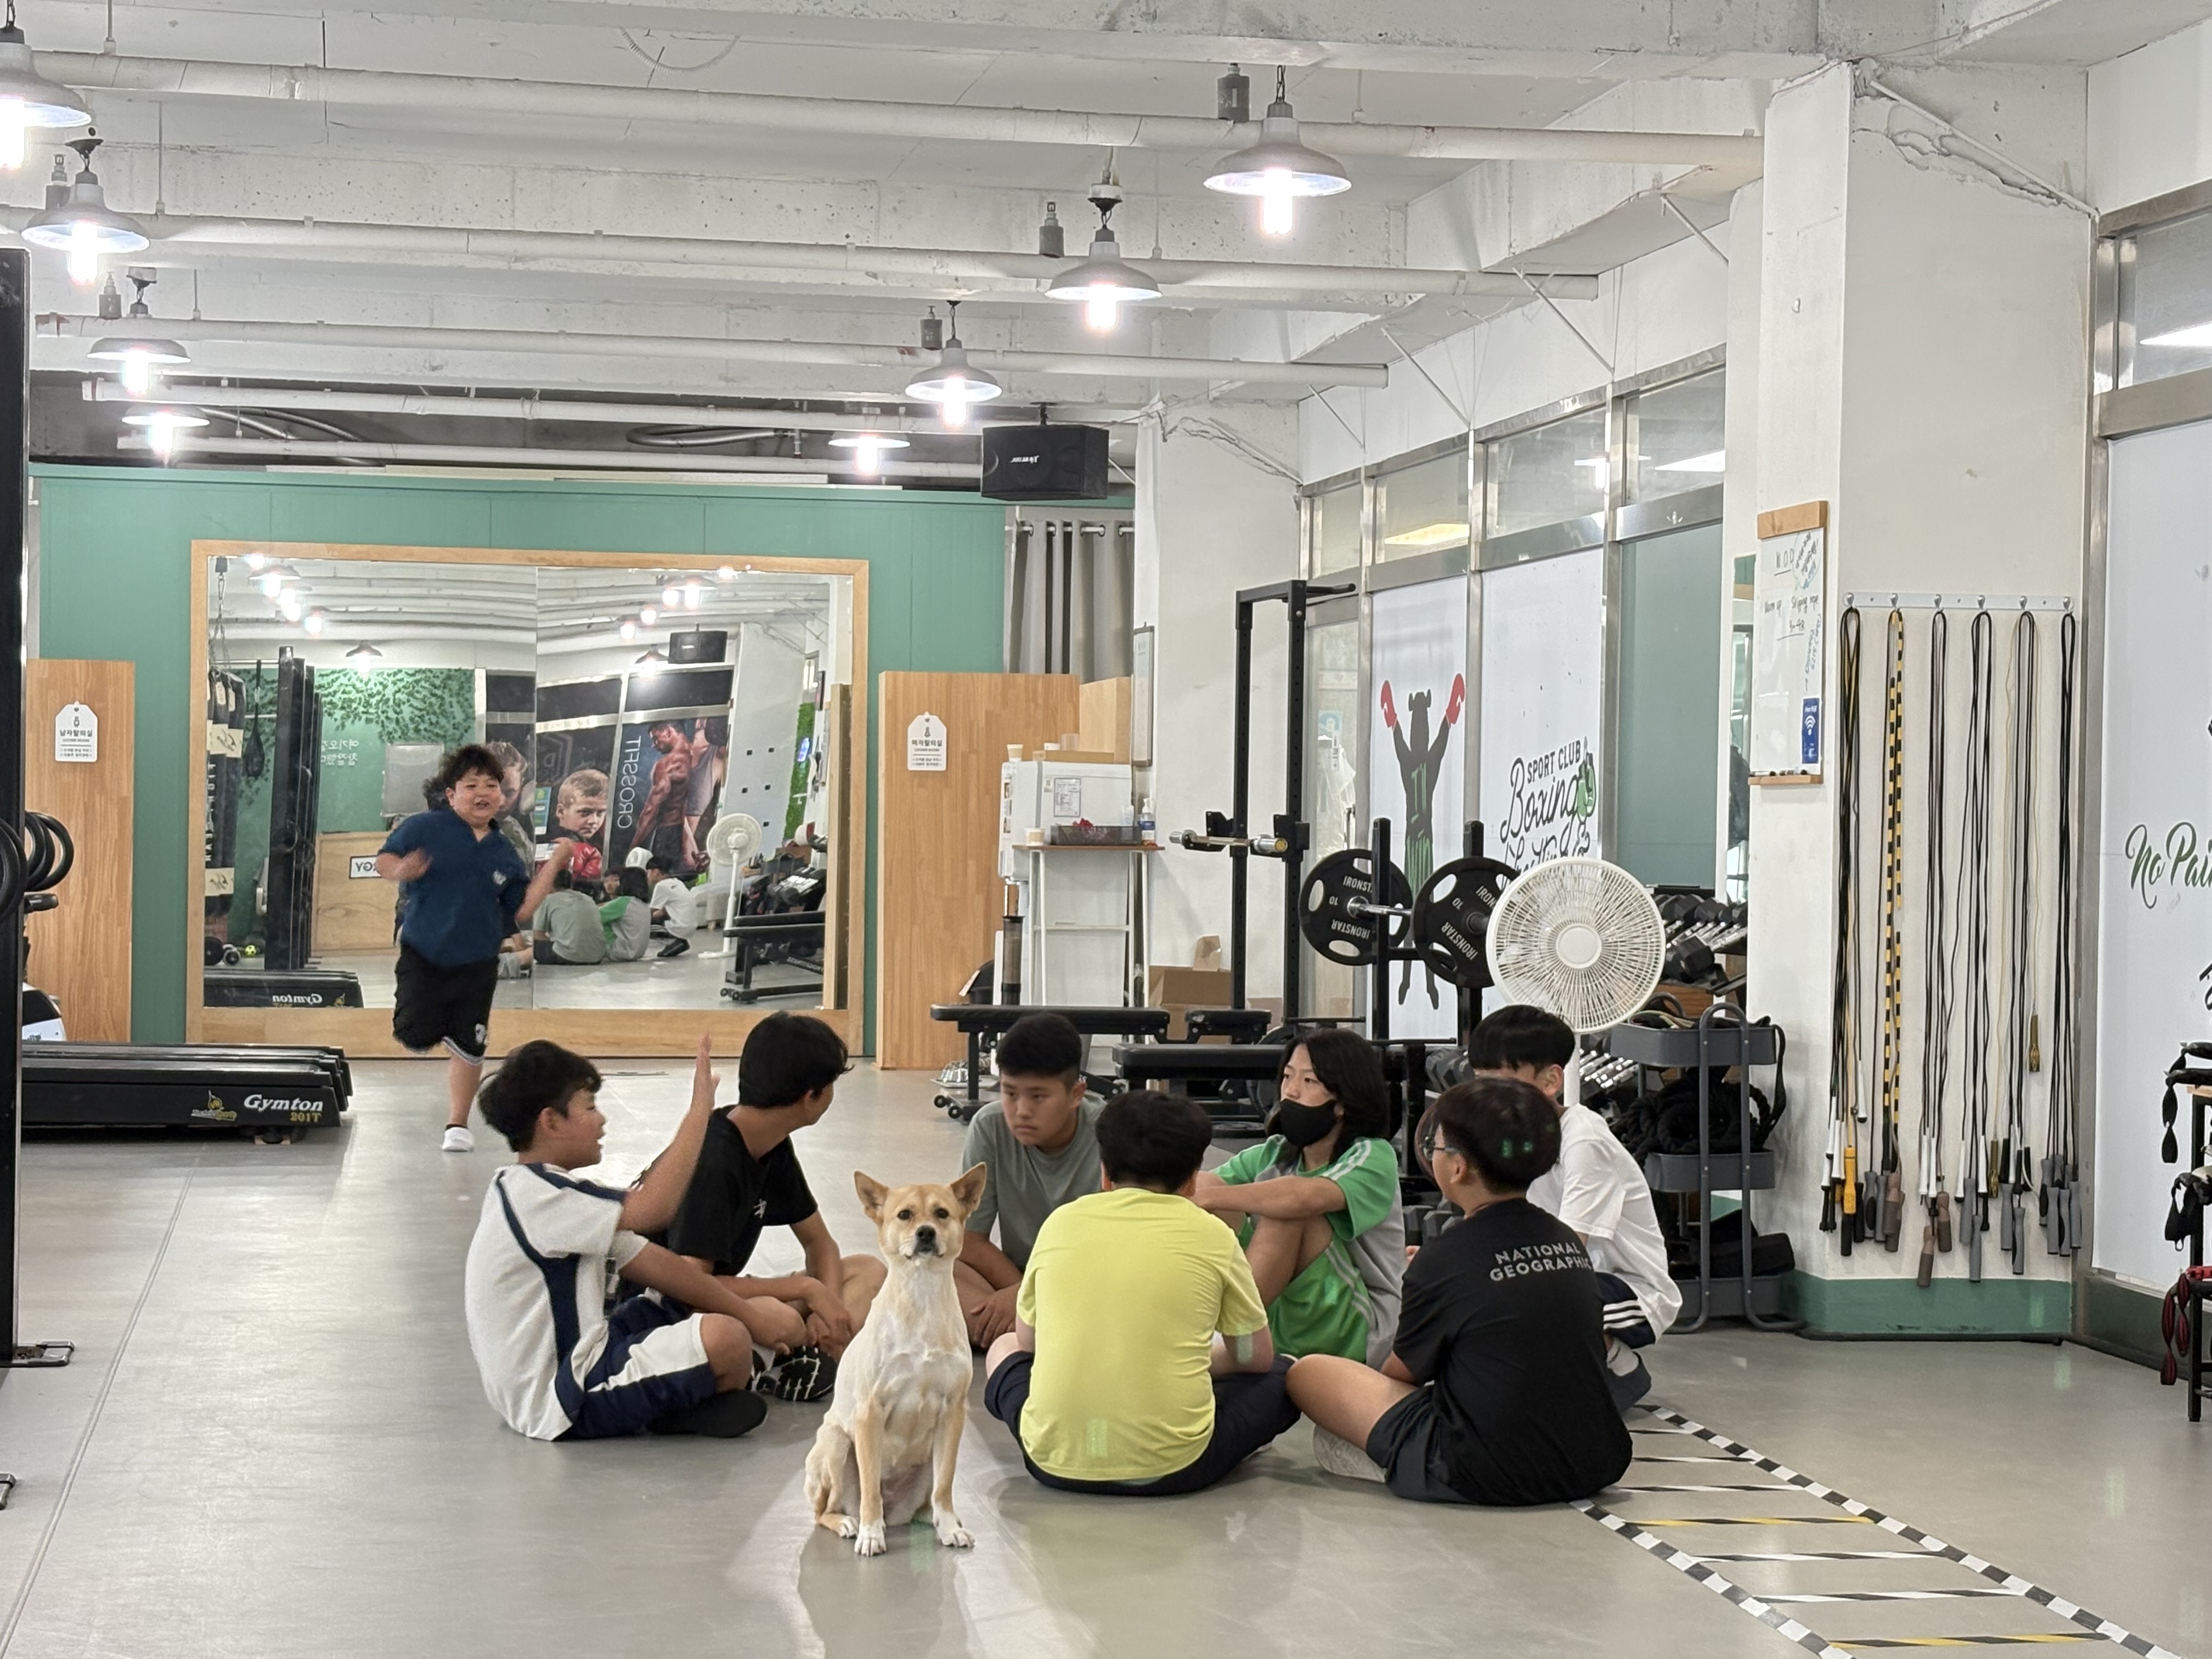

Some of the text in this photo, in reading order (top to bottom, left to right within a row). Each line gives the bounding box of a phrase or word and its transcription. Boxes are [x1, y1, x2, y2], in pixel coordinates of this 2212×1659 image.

[1527, 740, 1581, 784] SPORT CLUB
[1500, 757, 1580, 857] Boxing
[2125, 822, 2212, 909] No Pai
[1343, 876, 1372, 893] IRONST
[1329, 895, 1339, 906] 10
[1452, 898, 1464, 910] 10
[1475, 885, 1497, 909] IRON
[1331, 919, 1370, 939] IRONSTAR
[1441, 922, 1478, 960] IRONSTAR
[244, 1094, 323, 1111] Gymton
[290, 1113, 321, 1122] 201T
[1494, 1242, 1581, 1264] NATIONAL
